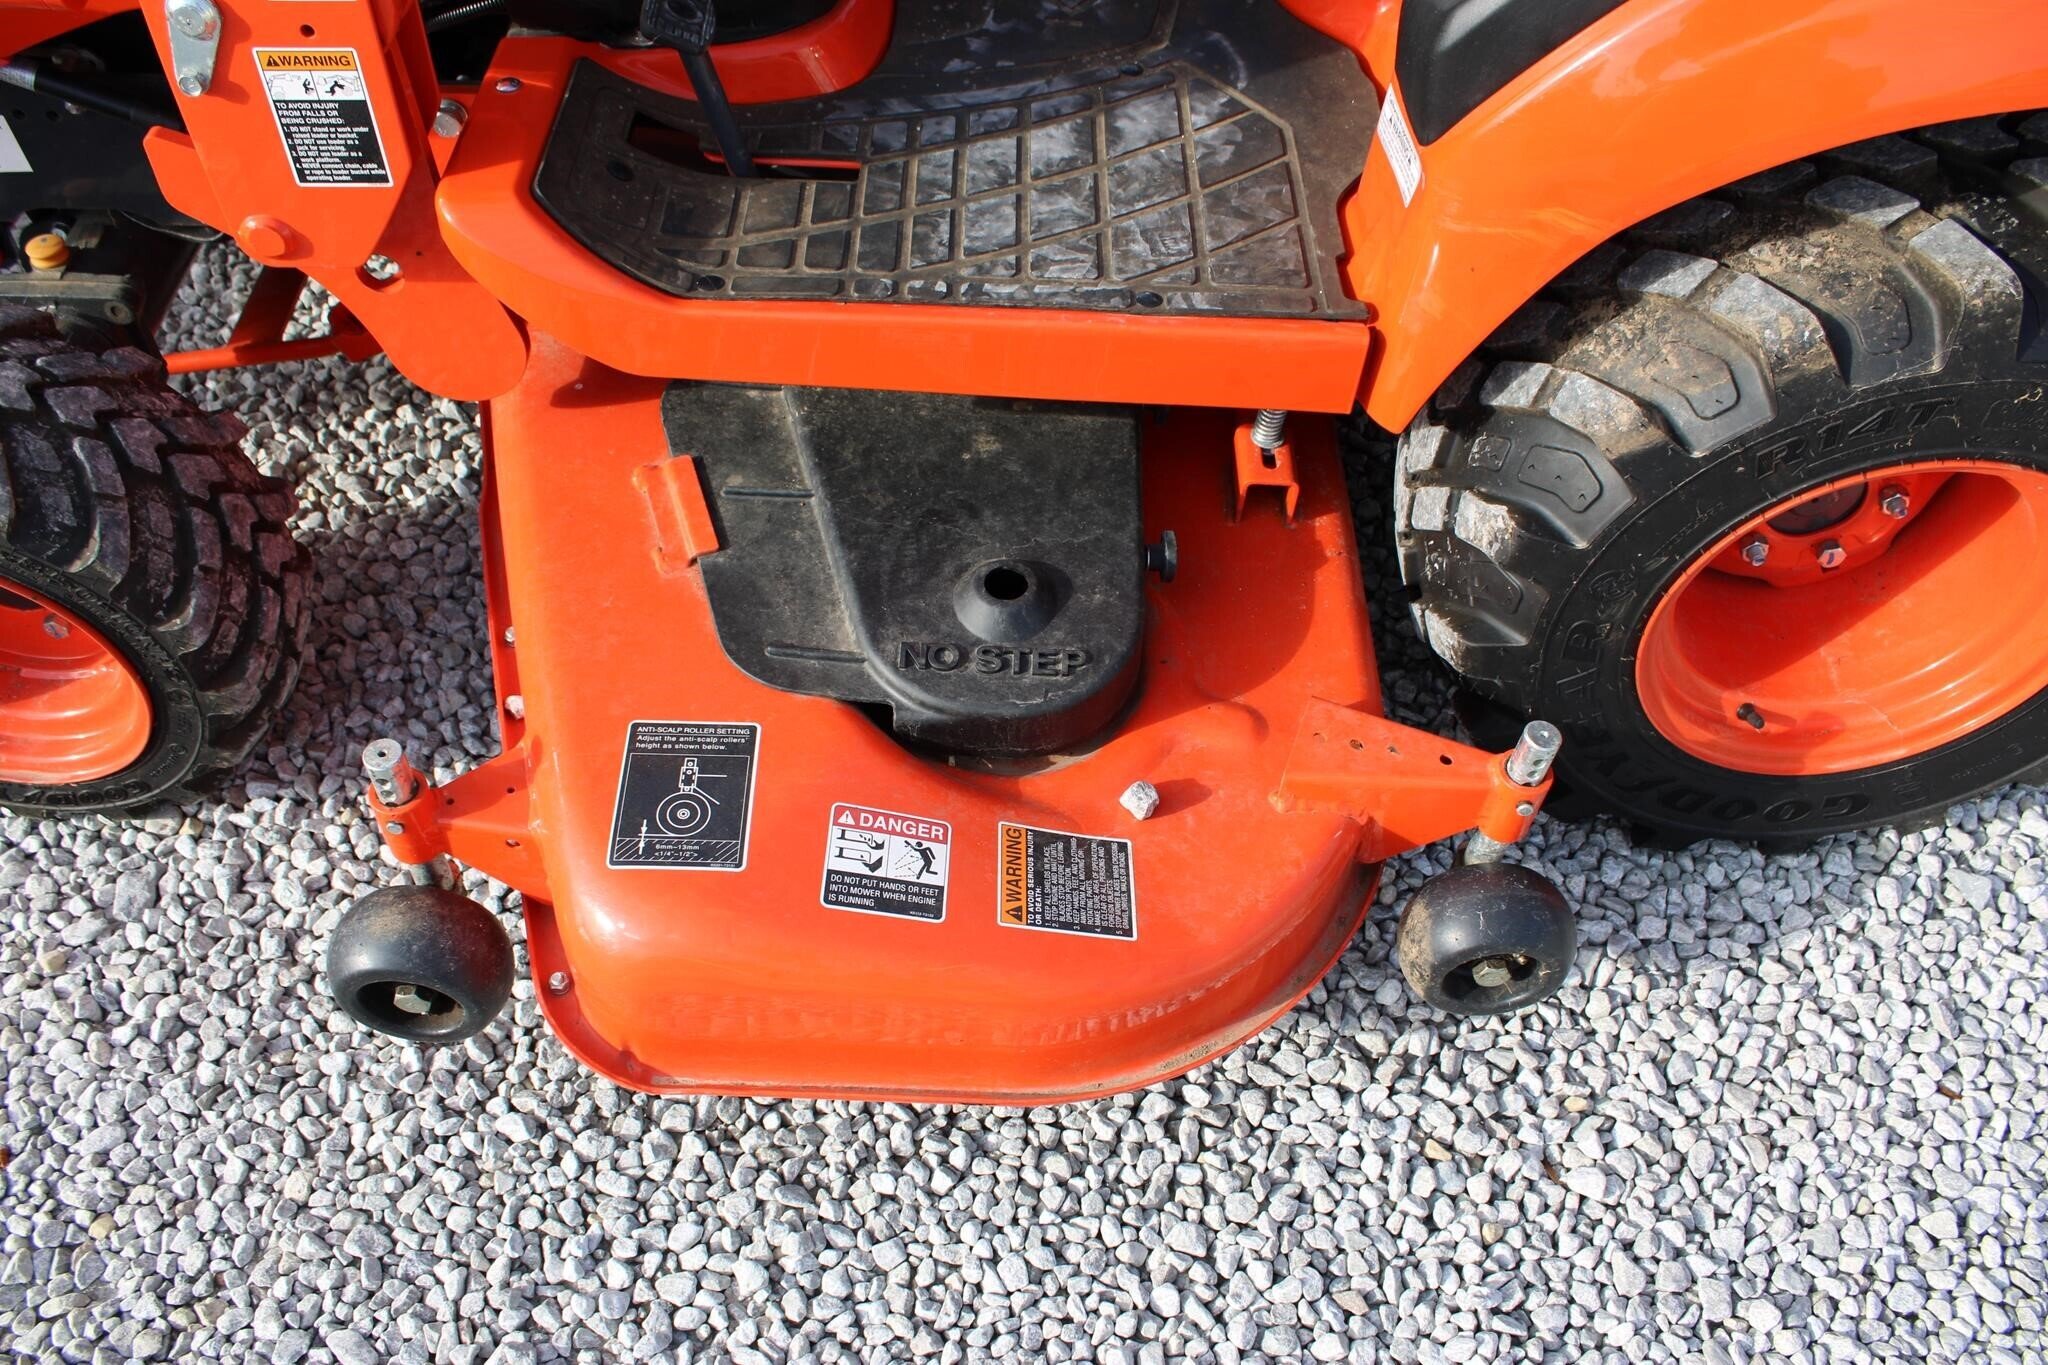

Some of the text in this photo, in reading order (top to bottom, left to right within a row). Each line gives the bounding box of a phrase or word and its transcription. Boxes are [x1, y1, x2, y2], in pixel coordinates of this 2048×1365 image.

[278, 55, 351, 67] WARNING
[898, 641, 1088, 677] NO STEP
[636, 734, 662, 742] Adjust
[859, 812, 944, 840] DANGER
[1006, 828, 1022, 903] WARNING
[830, 873, 938, 896] DO NOT PUT HANDS OR FEET
[828, 893, 874, 906] IS RUNNING
[829, 883, 936, 905] INTO MOWER WHEN ENGINE
[1028, 913, 1033, 923] TO
[1035, 913, 1041, 924] OR
